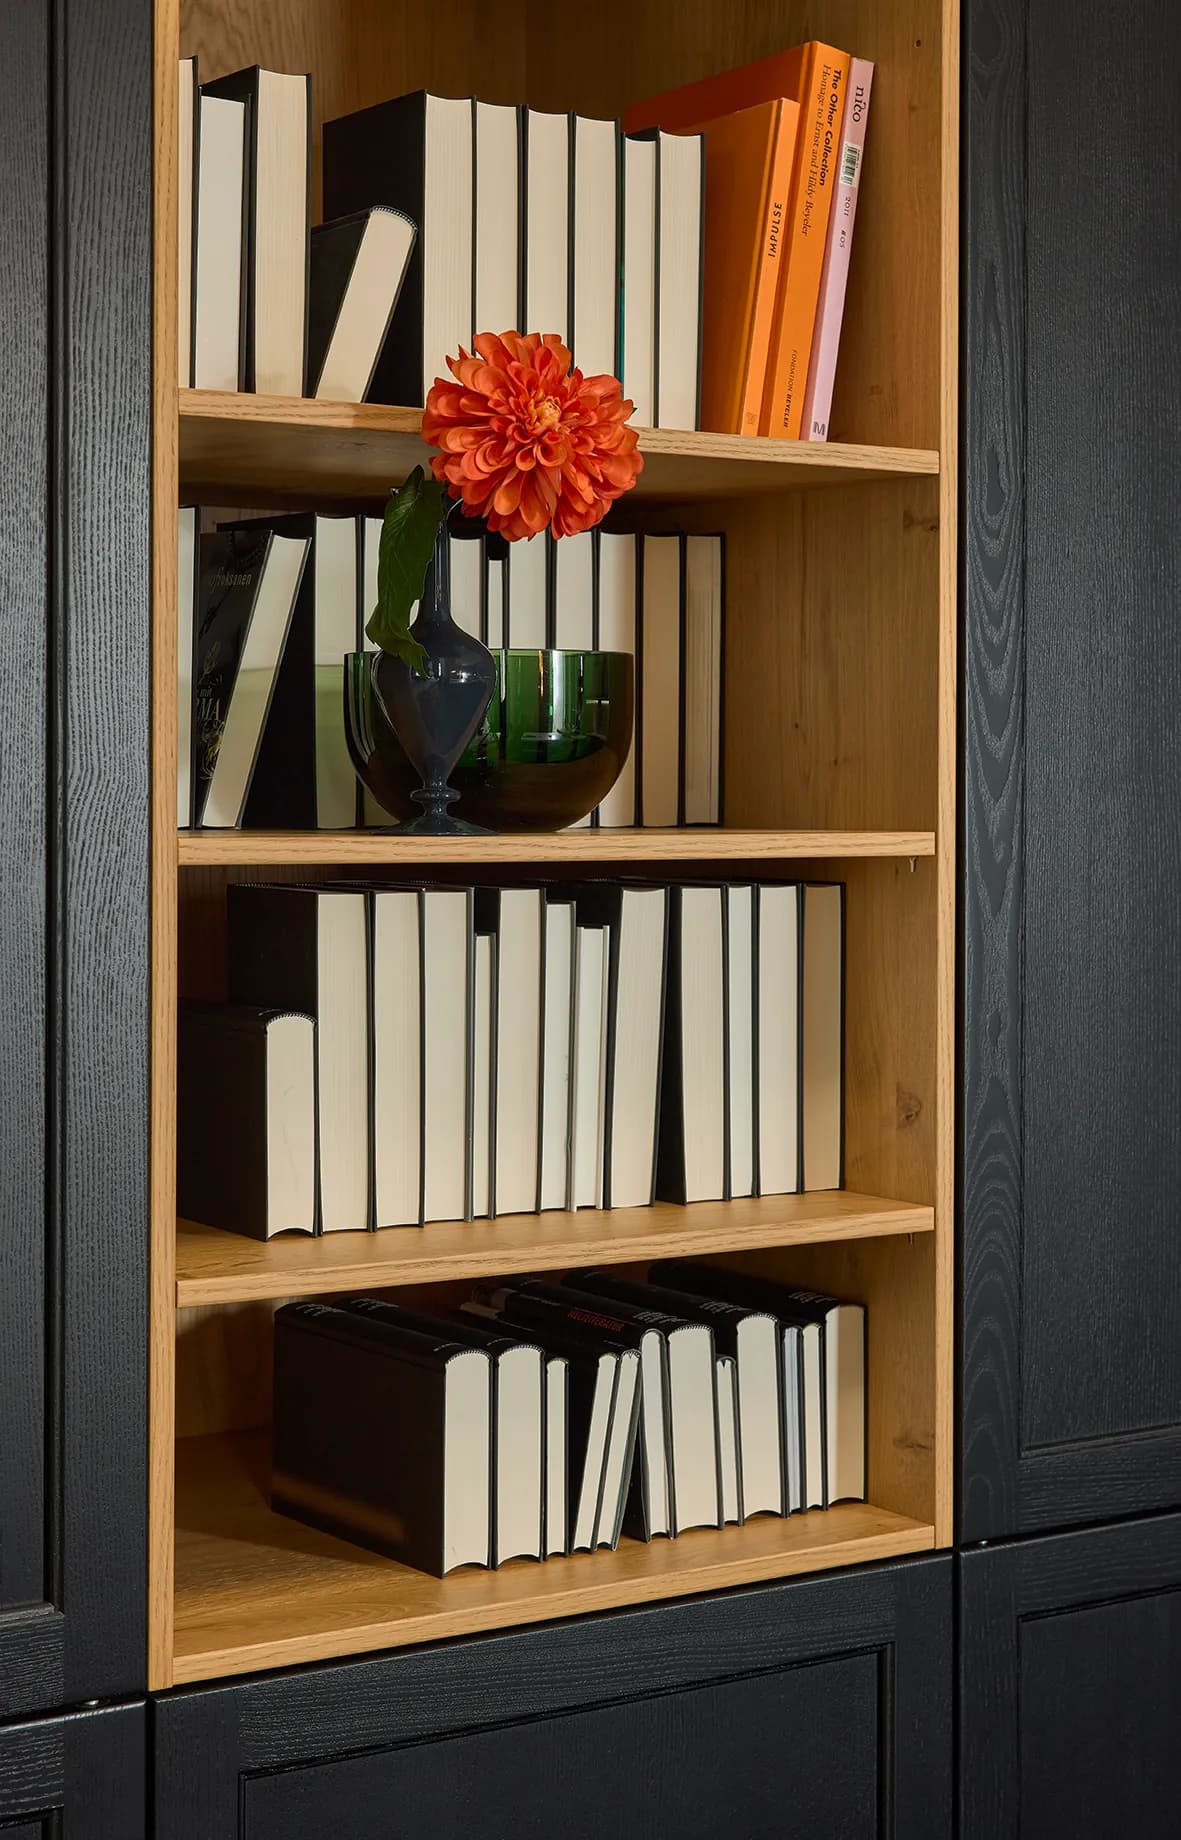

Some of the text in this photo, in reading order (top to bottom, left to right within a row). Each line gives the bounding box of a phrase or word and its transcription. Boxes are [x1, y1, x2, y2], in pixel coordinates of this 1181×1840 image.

[801, 64, 831, 237] Homage to Ernst and Hildy Beyeler
[819, 70, 842, 186] The Other Collection
[768, 202, 782, 258] IMPULSE
[843, 196, 851, 217] 2011
[787, 349, 798, 393] FONDATION
